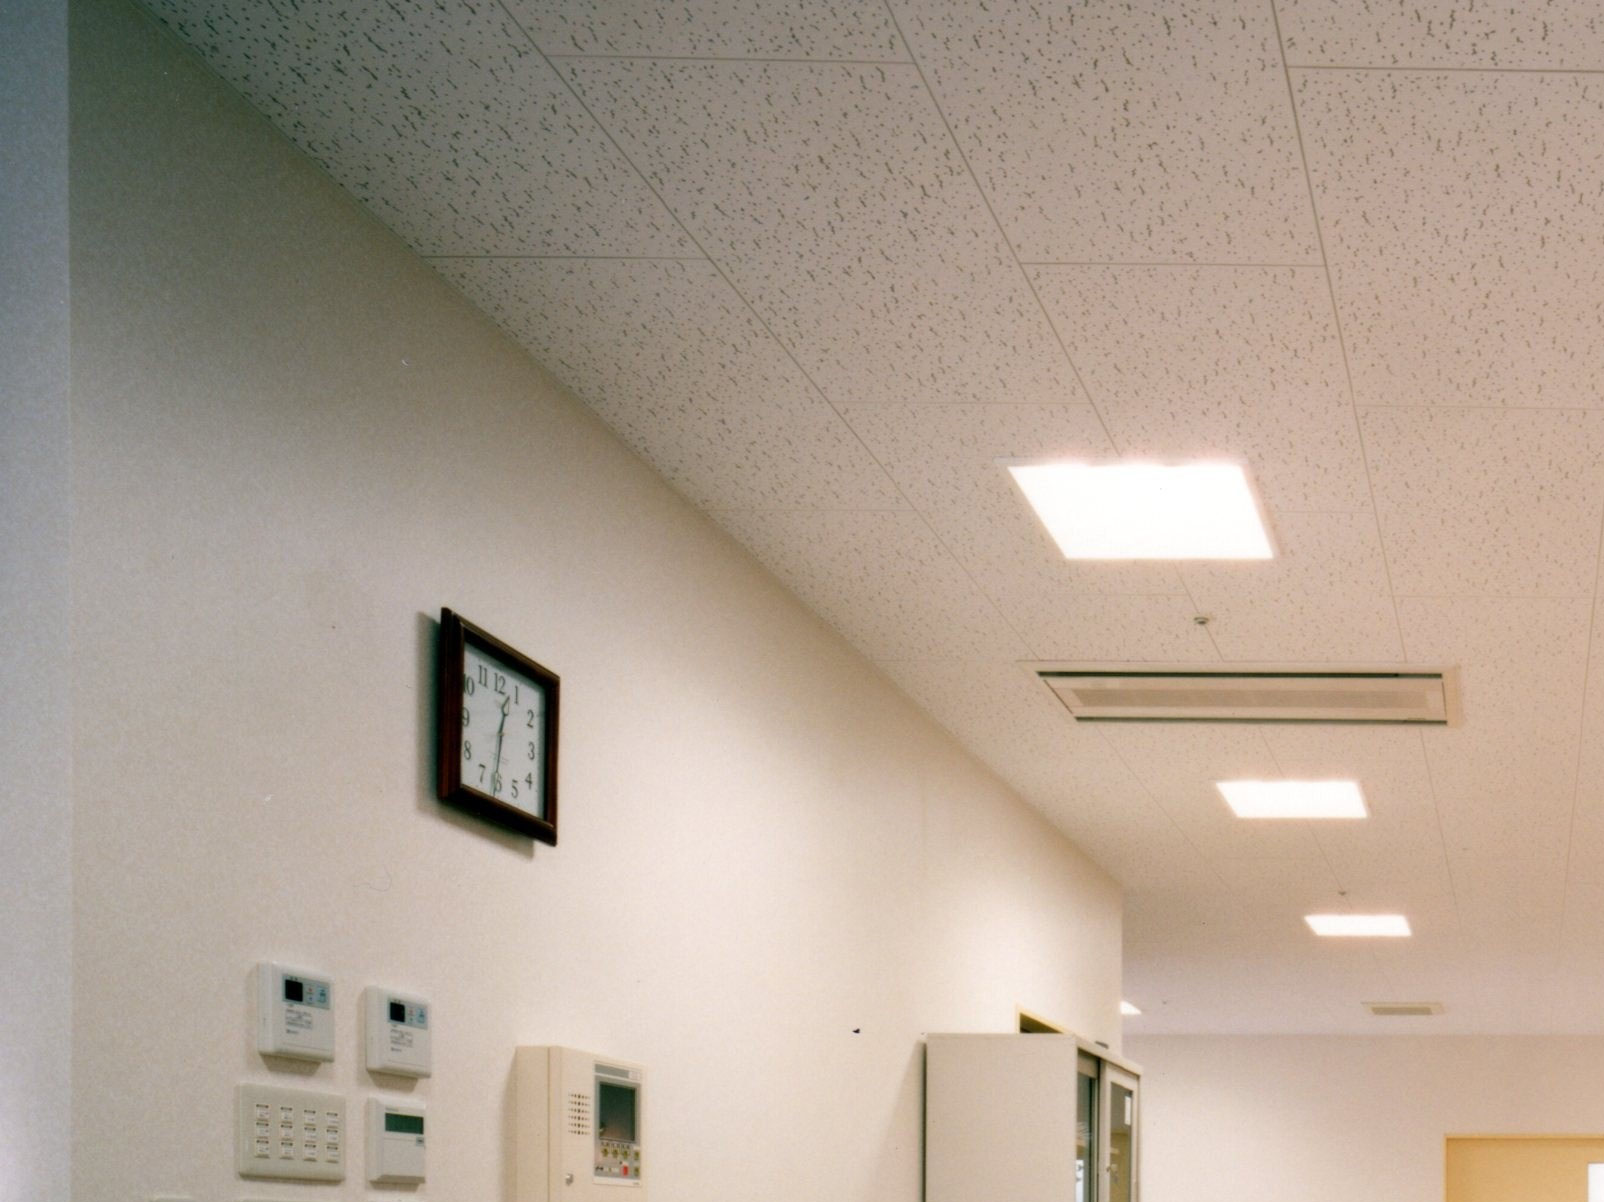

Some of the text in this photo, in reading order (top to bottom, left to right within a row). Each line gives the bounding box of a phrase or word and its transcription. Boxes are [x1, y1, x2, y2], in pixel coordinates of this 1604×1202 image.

[478, 664, 489, 690] 11
[494, 672, 506, 696] 12
[514, 685, 519, 706] 1
[526, 709, 534, 729] 2
[463, 740, 472, 761] 8
[527, 741, 535, 761] 3
[478, 763, 486, 785] 7
[524, 772, 533, 791] 4
[511, 778, 519, 799] 5
